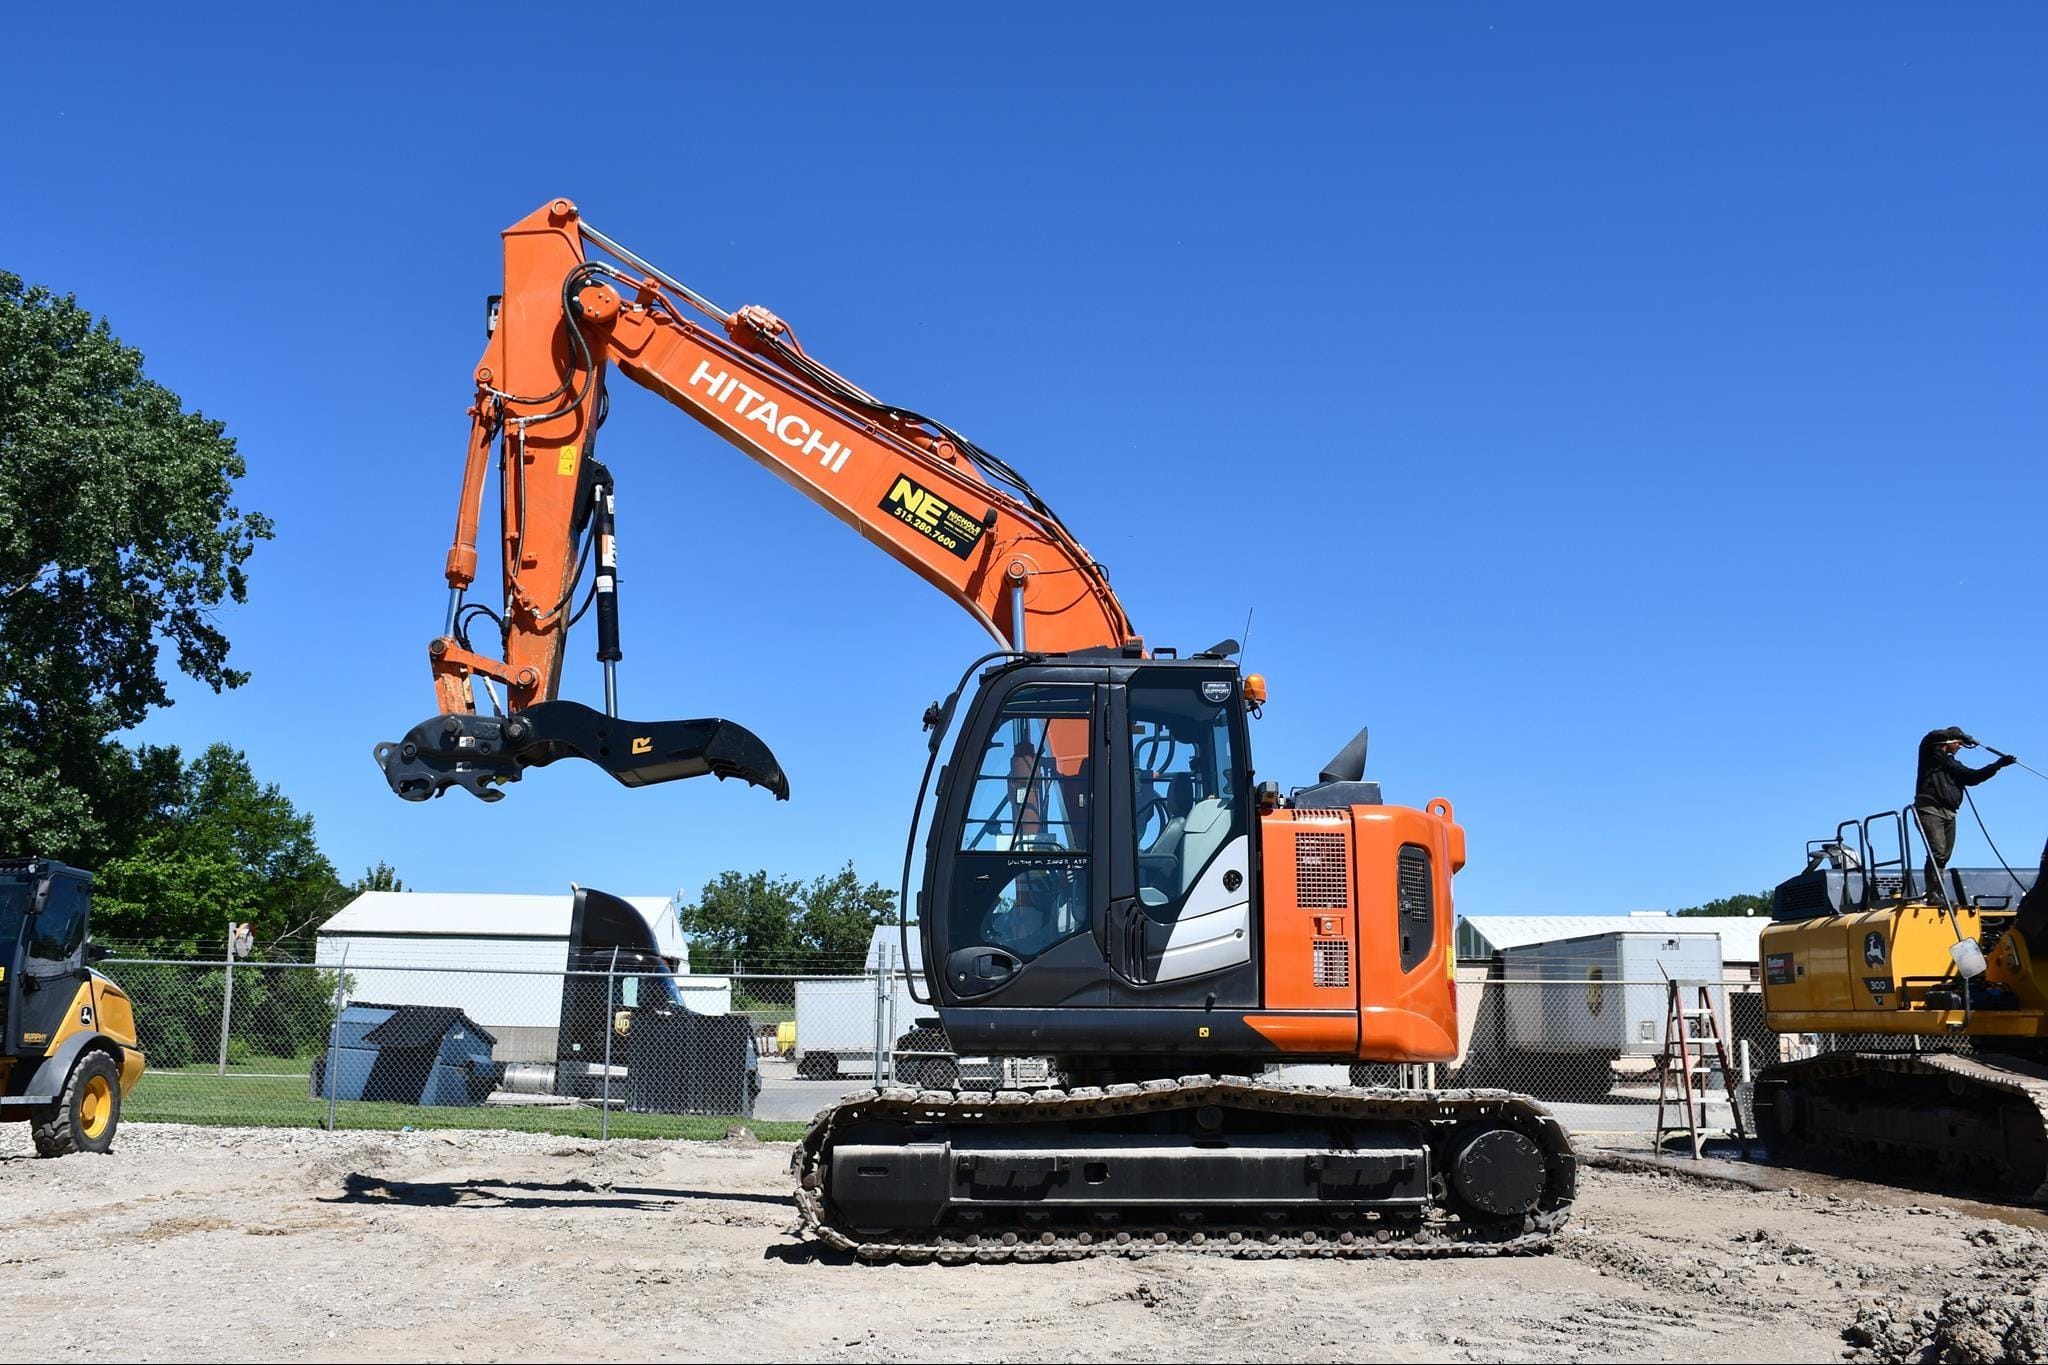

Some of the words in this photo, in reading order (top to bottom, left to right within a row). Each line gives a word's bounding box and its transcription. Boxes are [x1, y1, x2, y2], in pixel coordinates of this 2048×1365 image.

[689, 360, 852, 473] HITACHI
[889, 478, 949, 527] NE
[894, 507, 956, 549] 515.280.7600
[1870, 980, 1886, 990] 300
